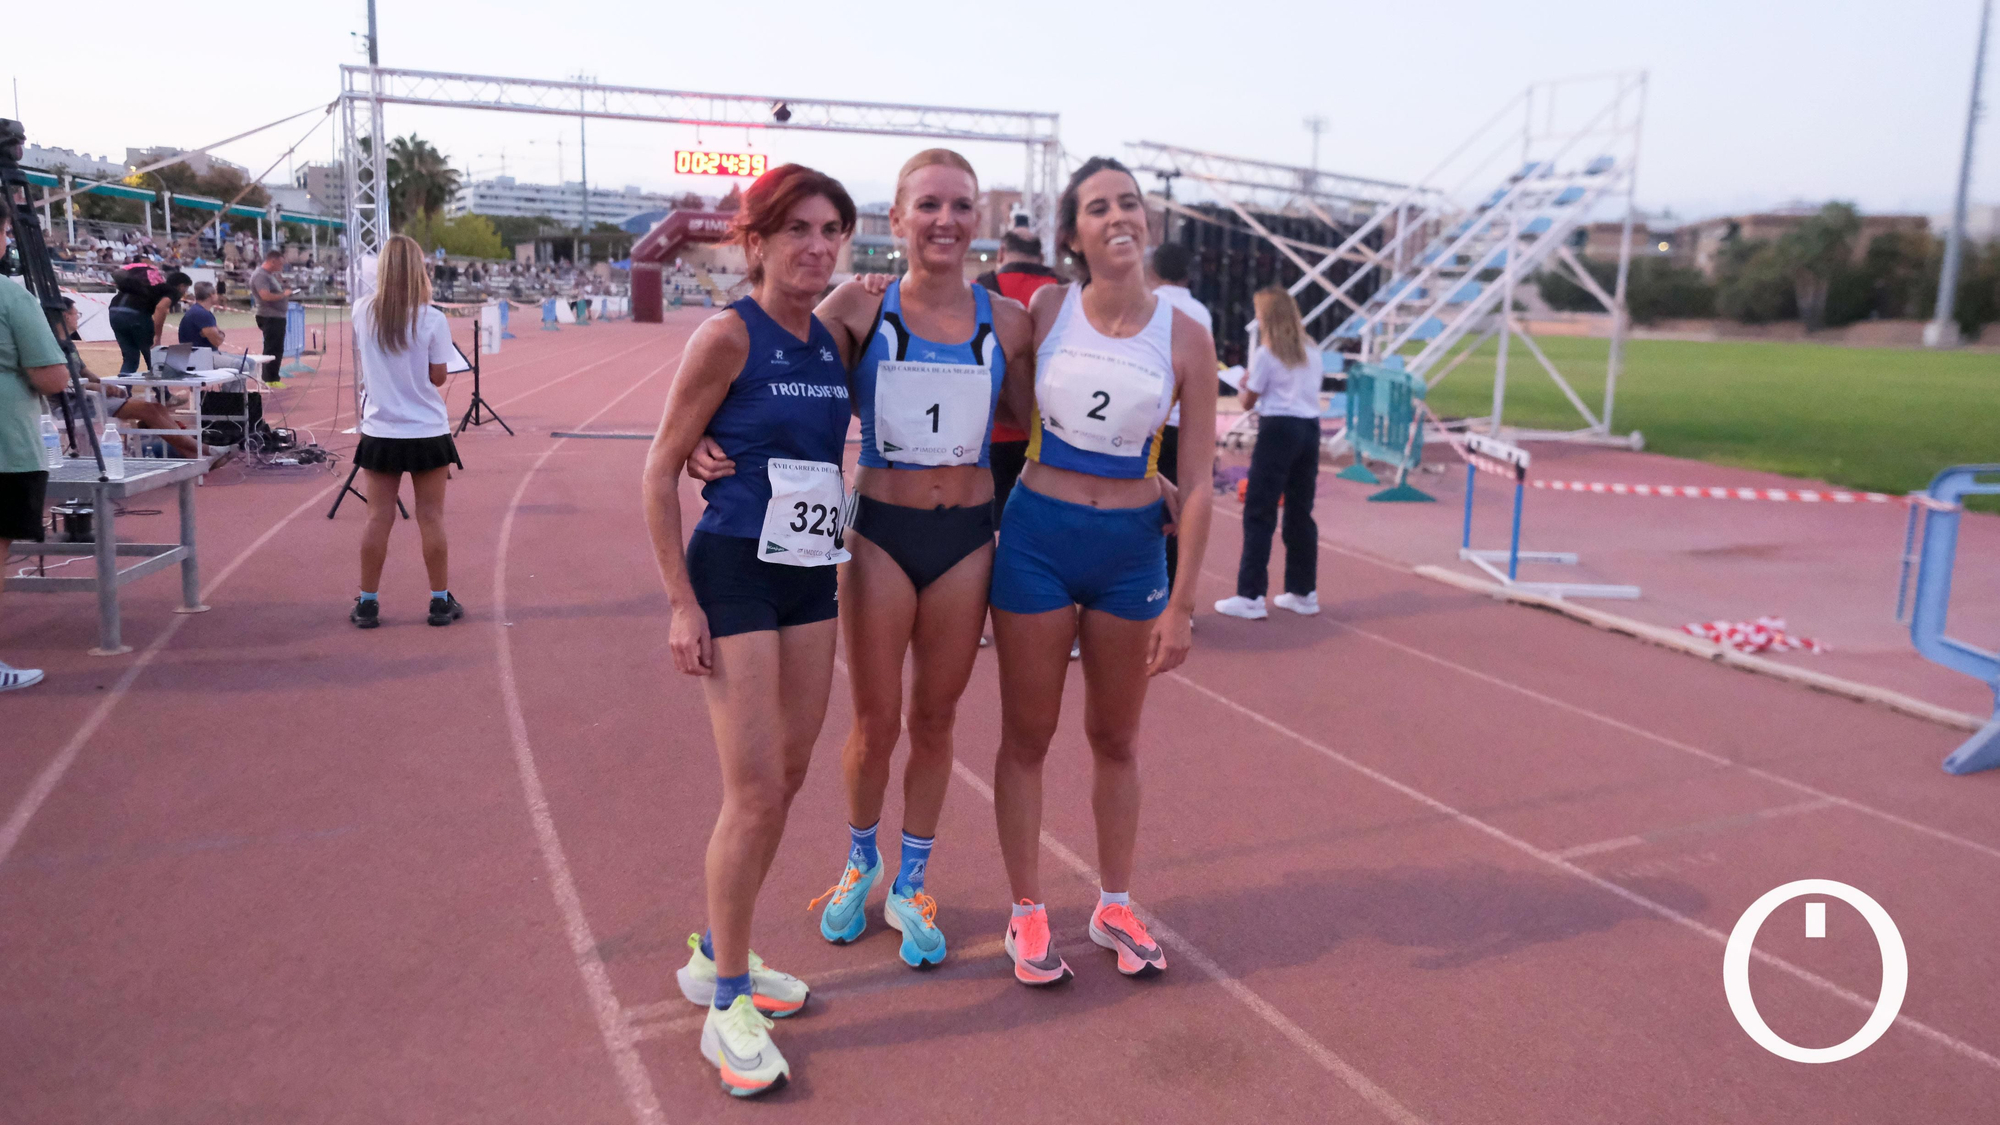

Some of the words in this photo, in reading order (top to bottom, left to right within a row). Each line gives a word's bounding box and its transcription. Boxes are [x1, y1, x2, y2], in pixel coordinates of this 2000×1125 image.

[677, 151, 765, 176] 00:24:39
[925, 403, 940, 433] 1
[1086, 391, 1110, 421] 2
[789, 463, 820, 472] CARRERA
